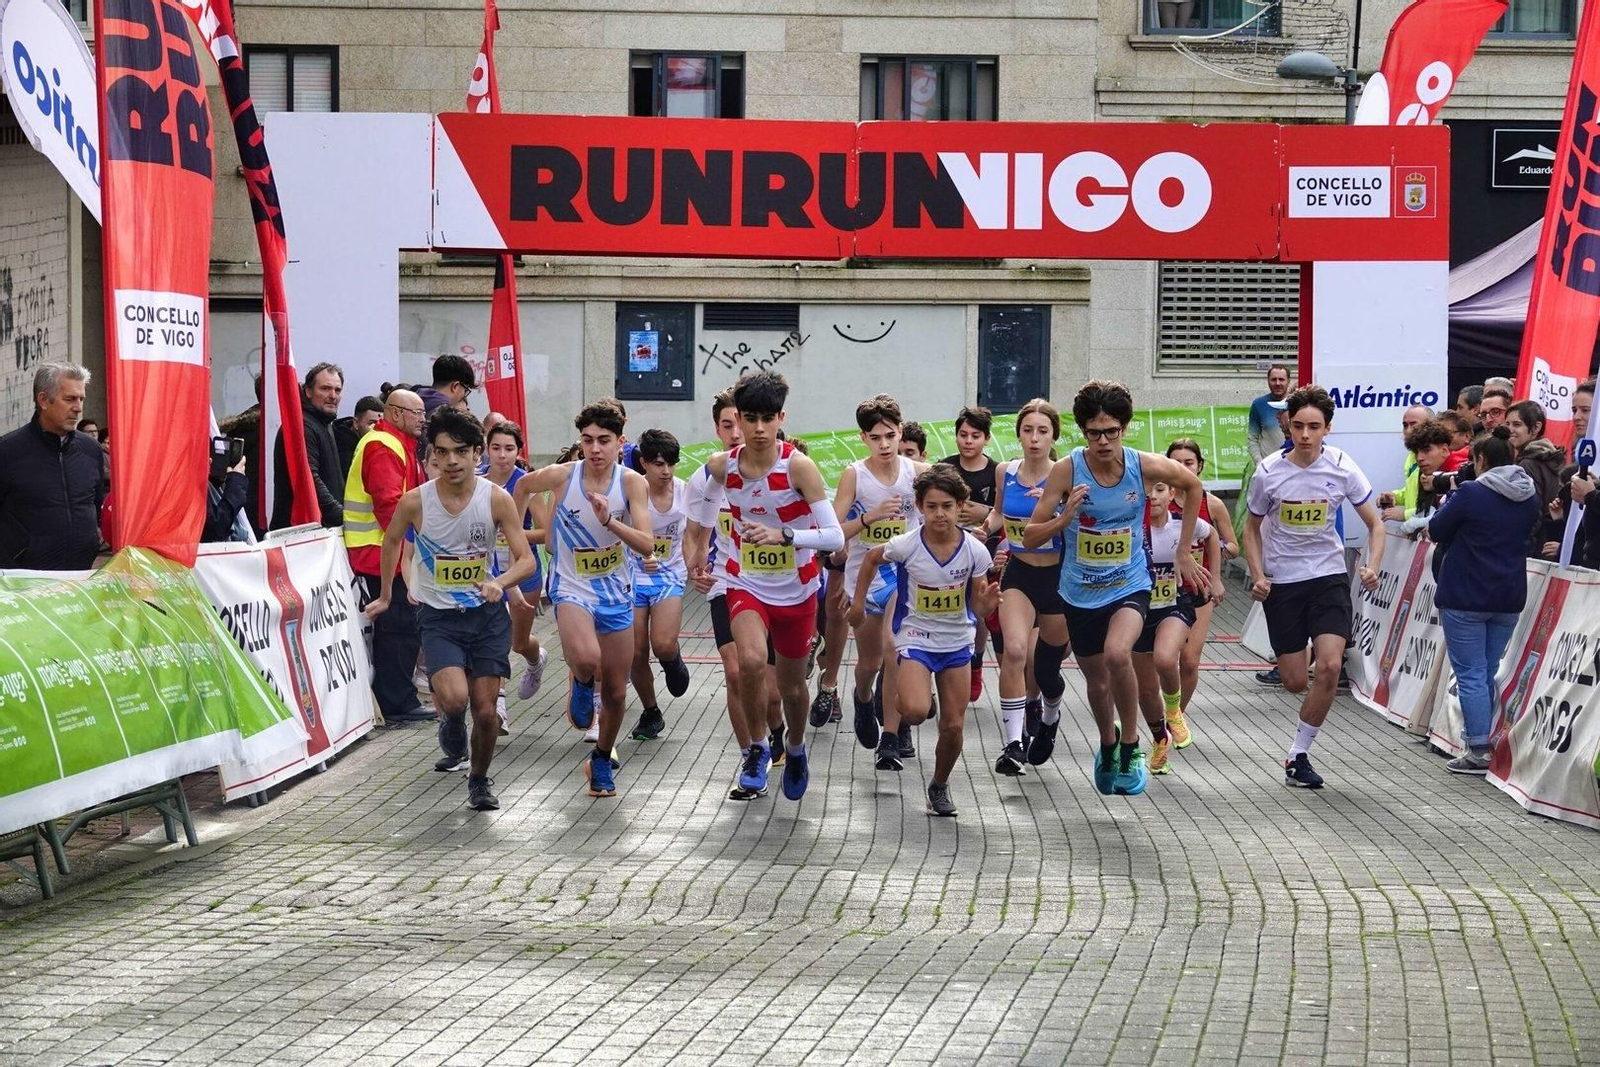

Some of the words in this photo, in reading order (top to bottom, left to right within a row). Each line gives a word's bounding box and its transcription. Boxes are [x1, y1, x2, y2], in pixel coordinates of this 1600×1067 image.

[1296, 177, 1383, 191] CONCELLO
[1306, 193, 1328, 207] DE
[1334, 193, 1373, 207] VIGO
[124, 304, 200, 327] CONCELLO
[136, 327, 154, 345] DE
[161, 328, 195, 348] VIGO
[1329, 384, 1439, 408] Atlántico
[1157, 417, 1179, 428] máis
[1185, 417, 1207, 428] auga
[1219, 414, 1240, 425] máis
[1221, 445, 1242, 456] máis
[1286, 509, 1322, 521] 1412
[866, 526, 900, 539] 1605
[1084, 540, 1125, 555] 1603
[581, 552, 618, 570] 1405
[748, 550, 787, 566] 1601
[442, 565, 481, 580] 1607
[923, 594, 960, 609] 1411
